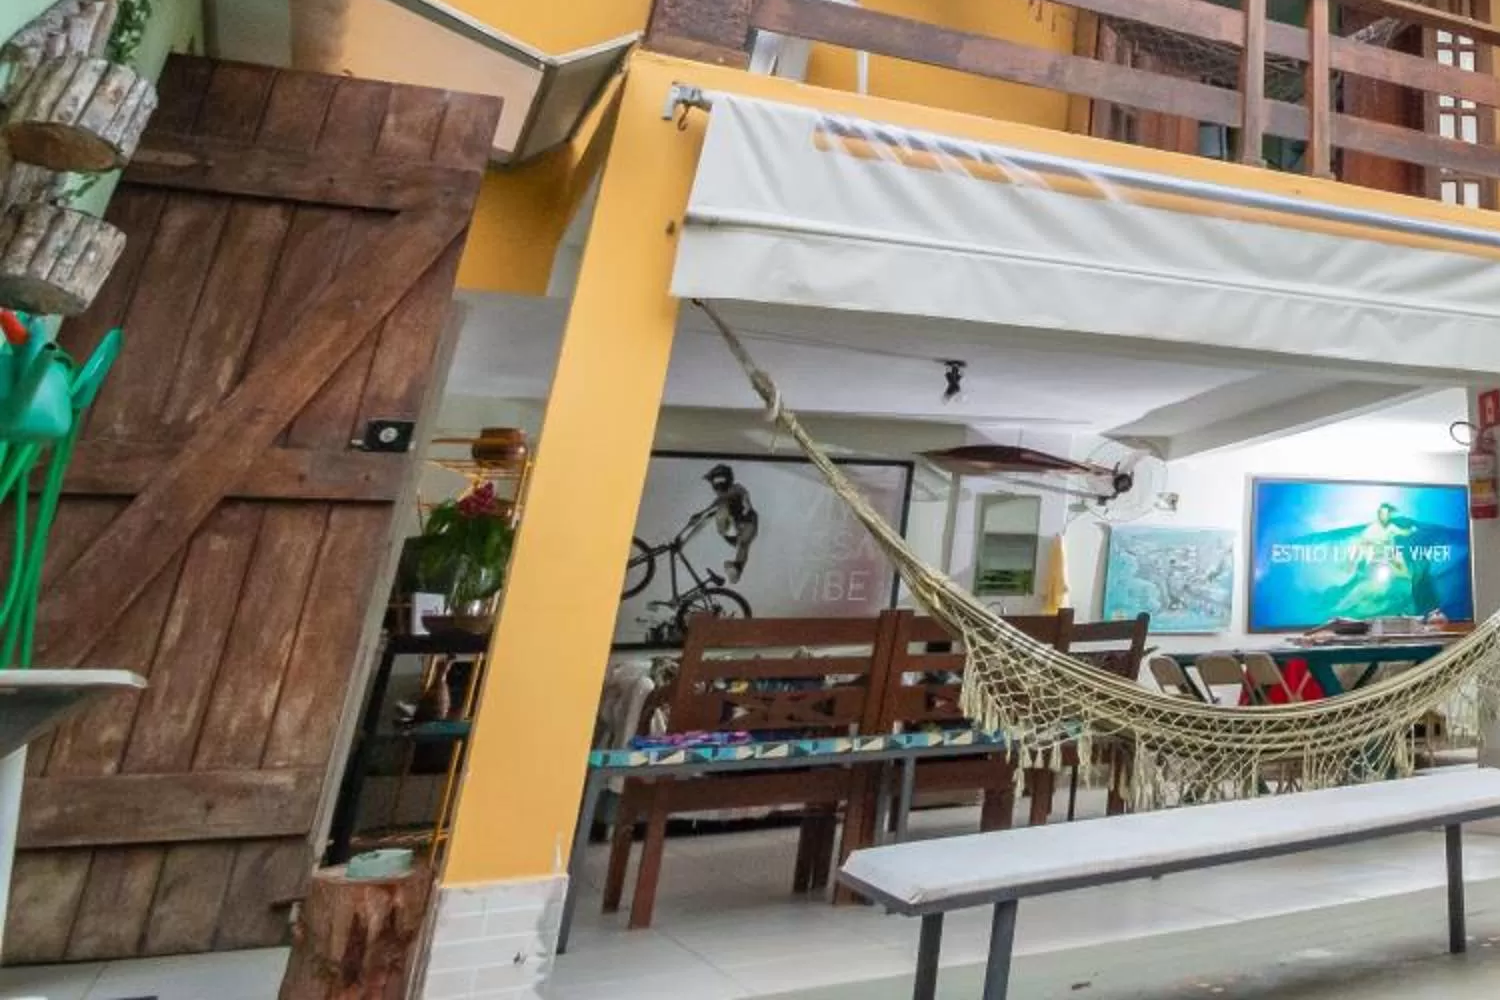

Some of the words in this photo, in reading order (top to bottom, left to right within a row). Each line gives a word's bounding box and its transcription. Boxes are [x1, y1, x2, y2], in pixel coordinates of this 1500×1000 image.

[1271, 543, 1327, 563] ESTILO
[1384, 545, 1405, 562] DE
[1409, 545, 1452, 562] VIVER
[788, 570, 871, 601] VIBE
